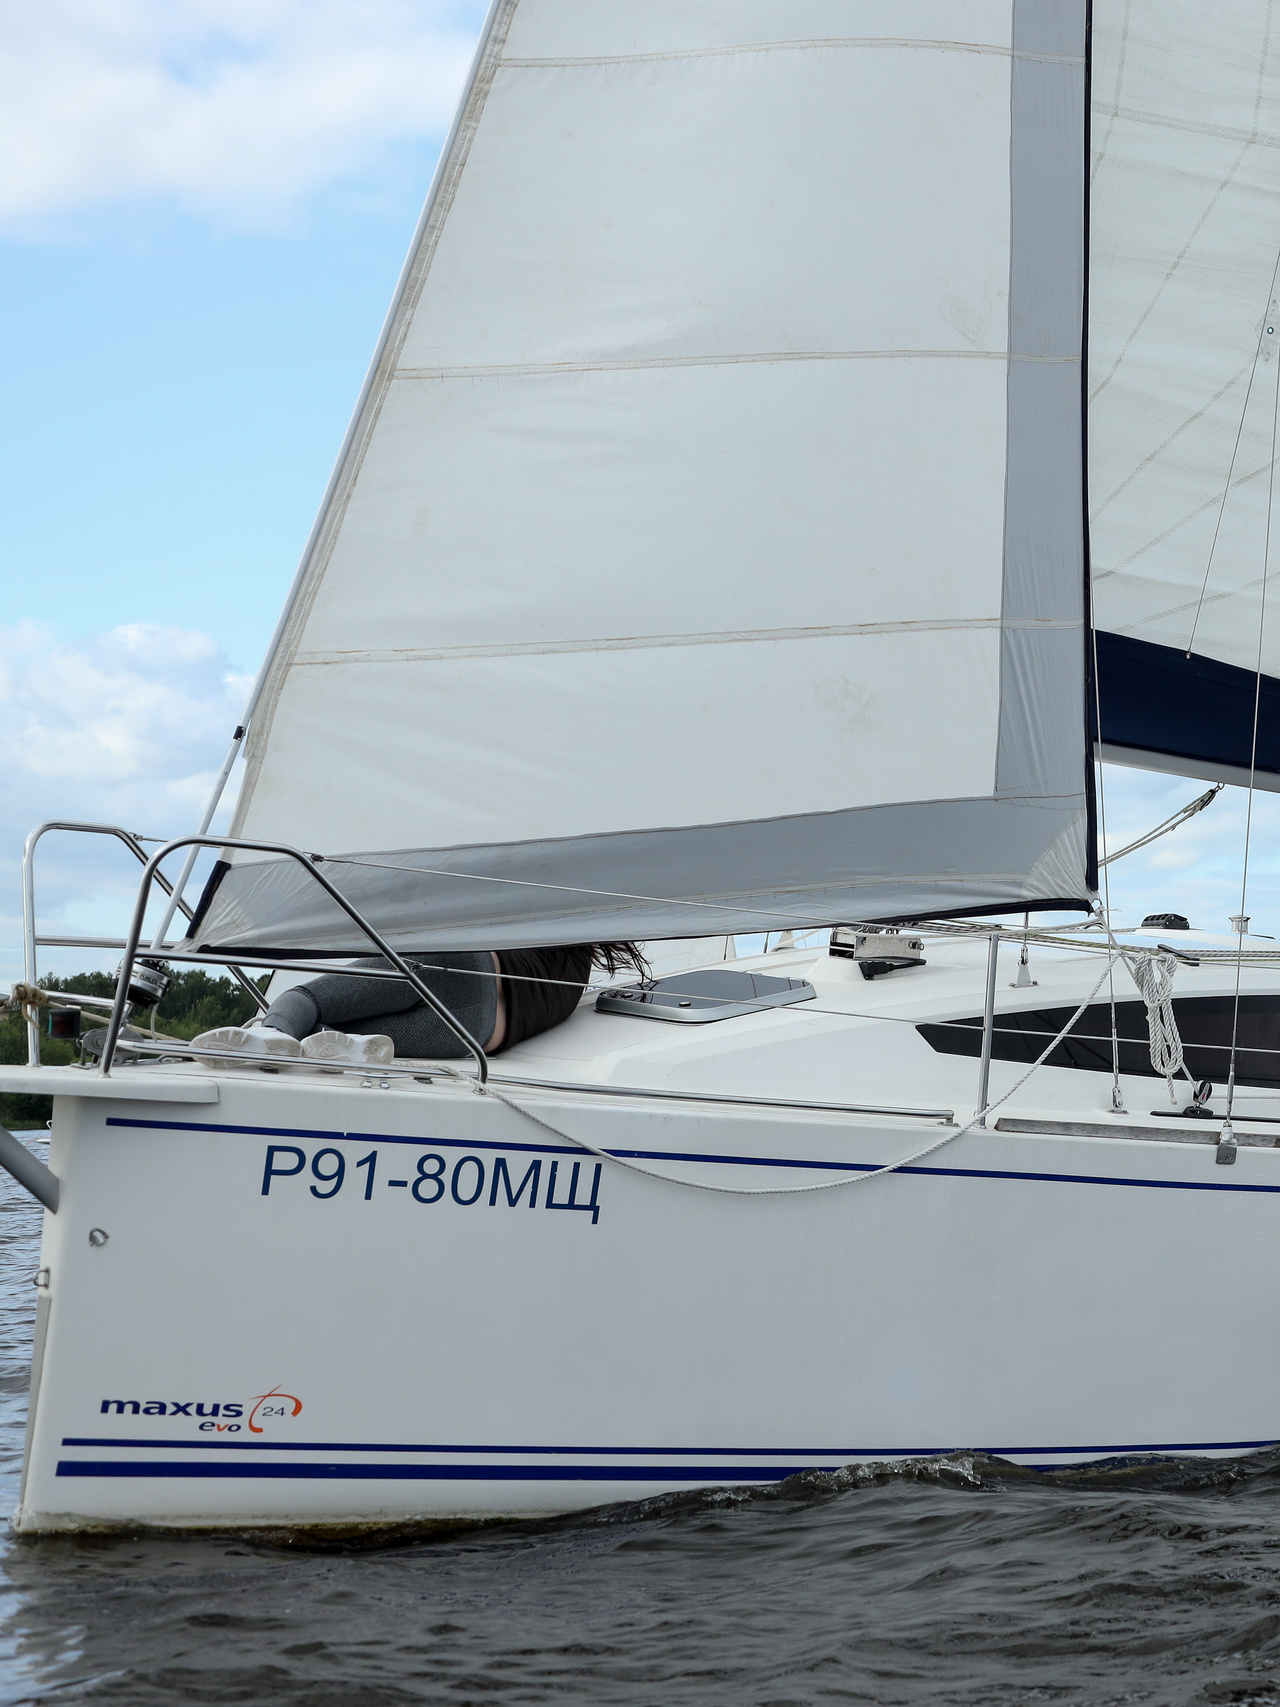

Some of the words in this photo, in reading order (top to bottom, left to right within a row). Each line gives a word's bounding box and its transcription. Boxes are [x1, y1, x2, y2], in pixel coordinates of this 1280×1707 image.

[261, 1145, 602, 1225] Р91-80МЩ
[100, 1399, 243, 1417] maxus
[262, 1406, 286, 1416] 24
[198, 1421, 241, 1432] evo
